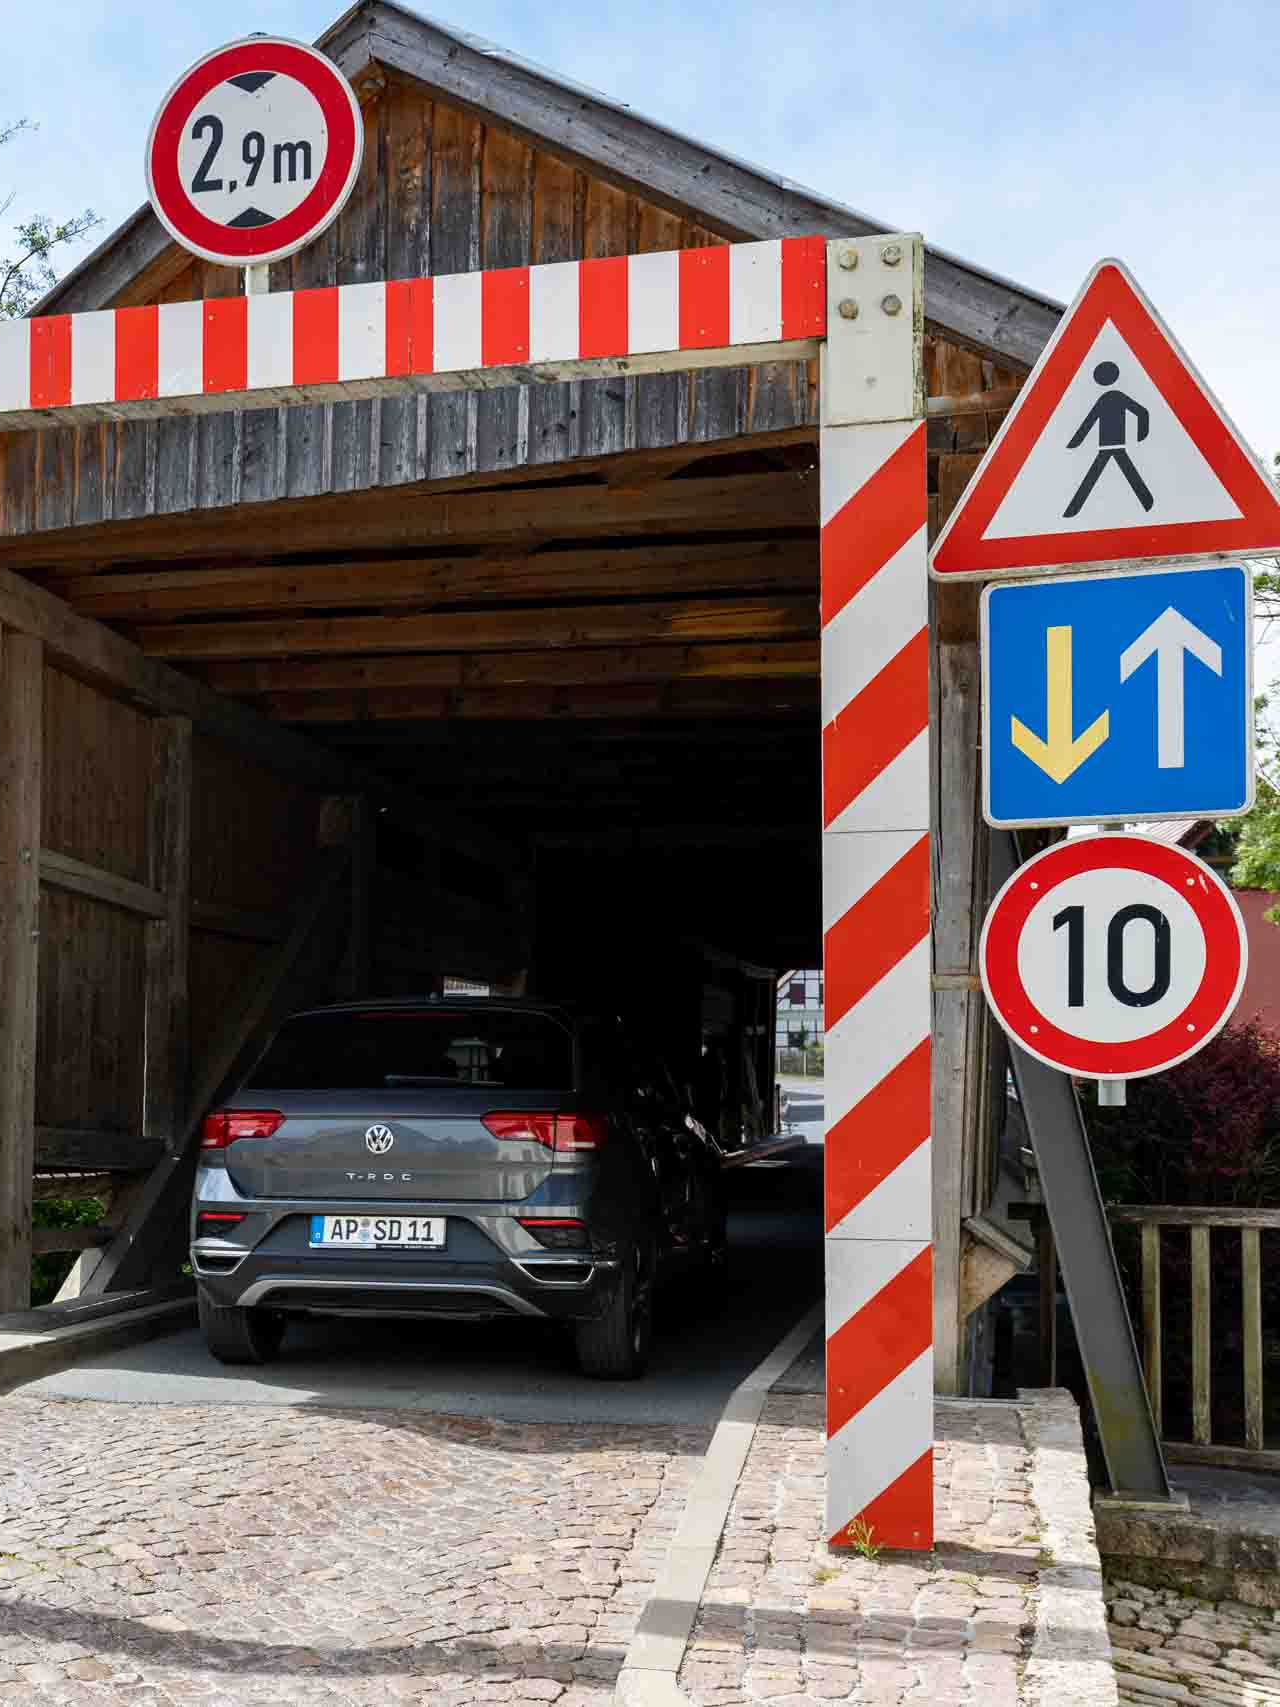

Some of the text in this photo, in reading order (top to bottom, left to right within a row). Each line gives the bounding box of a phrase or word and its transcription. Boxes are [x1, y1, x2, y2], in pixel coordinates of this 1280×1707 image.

[1051, 904, 1171, 1009] 10
[344, 1172, 412, 1181] T-ROC
[331, 1219, 435, 1242] AP SD 11
